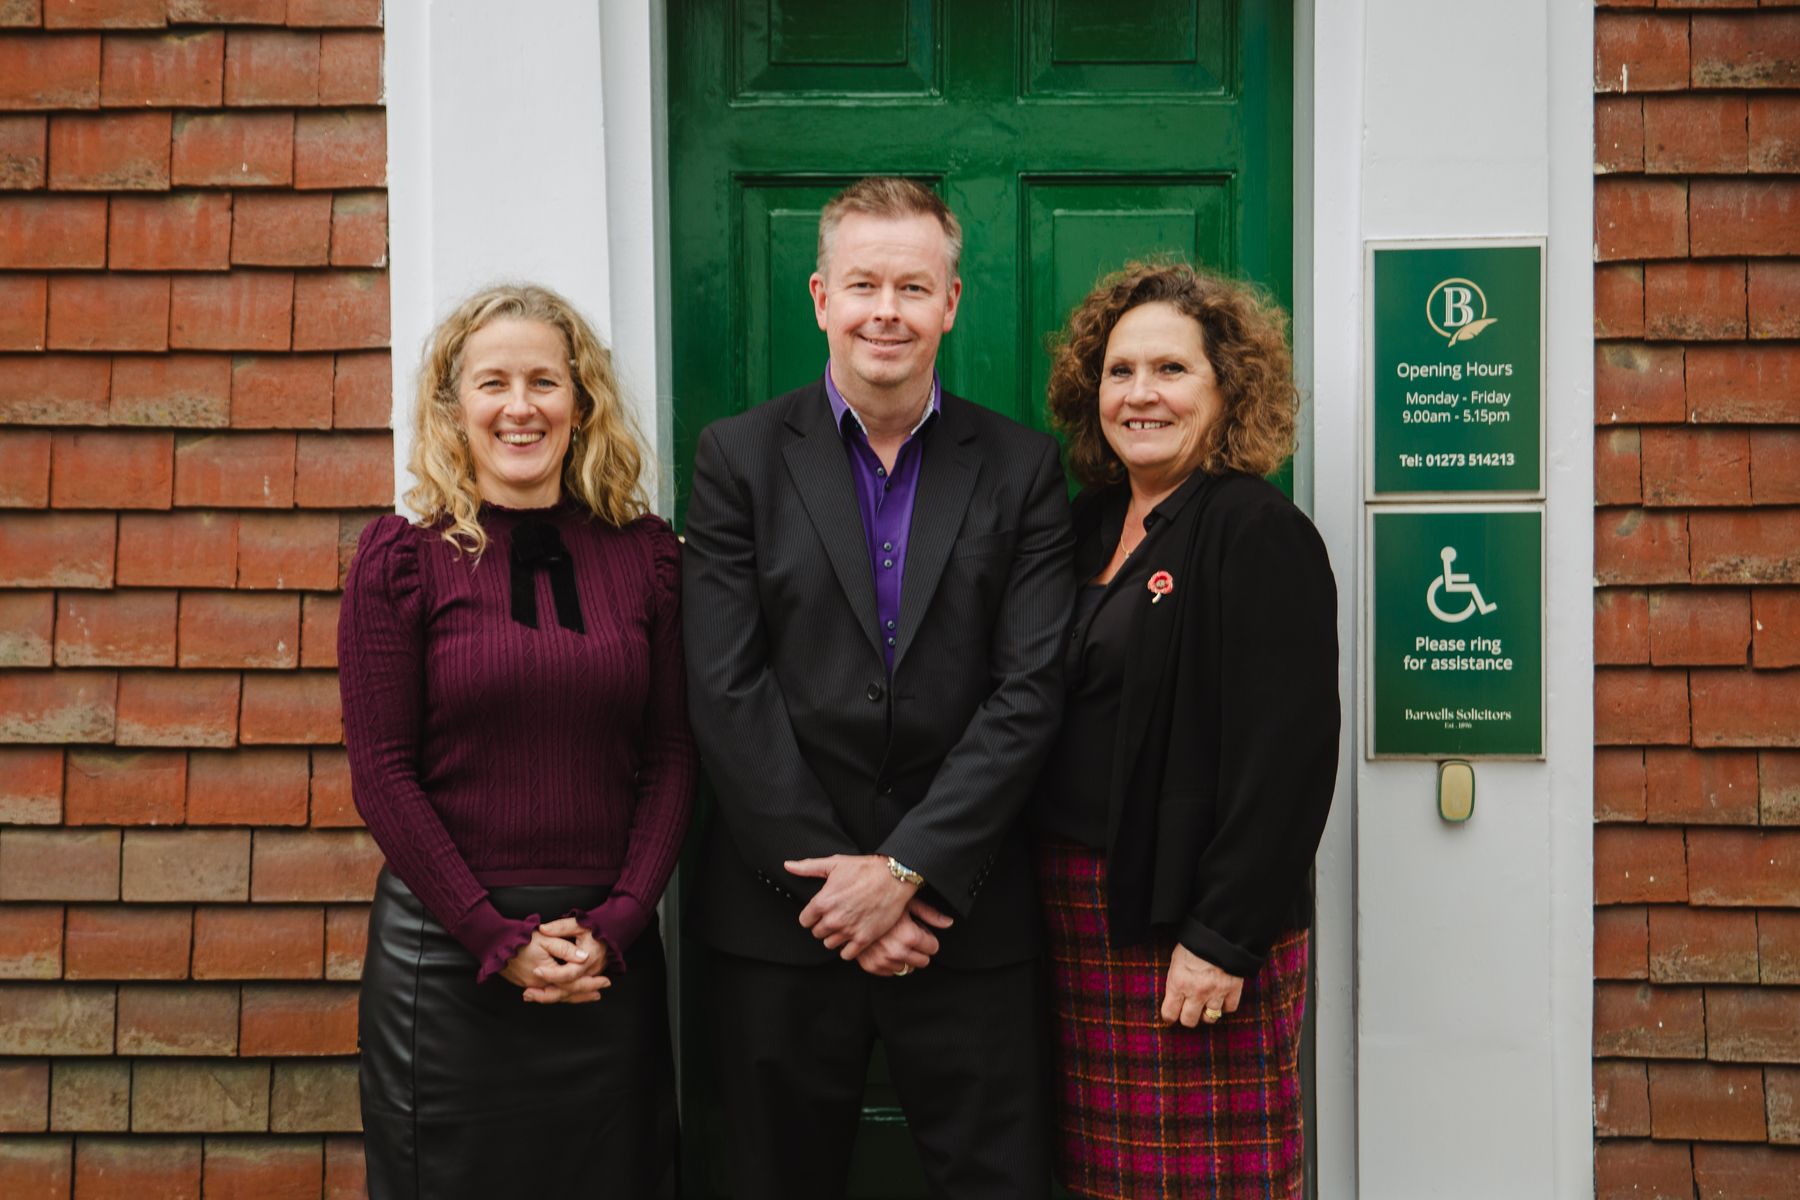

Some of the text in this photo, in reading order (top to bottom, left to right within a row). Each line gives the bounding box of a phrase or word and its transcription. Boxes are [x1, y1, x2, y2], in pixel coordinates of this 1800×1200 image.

[1443, 286, 1474, 327] B
[1396, 361, 1513, 381] Opening Hours
[1405, 390, 1459, 408] Monday
[1470, 390, 1511, 407] Friday
[1402, 409, 1451, 423] 9.00am
[1463, 408, 1510, 426] 5.15pm
[1399, 452, 1515, 467] Tel: 01273 514213
[1415, 635, 1502, 655] Please ring
[1403, 655, 1513, 671] for assistance
[1405, 707, 1512, 721] Barwells Solicitors
